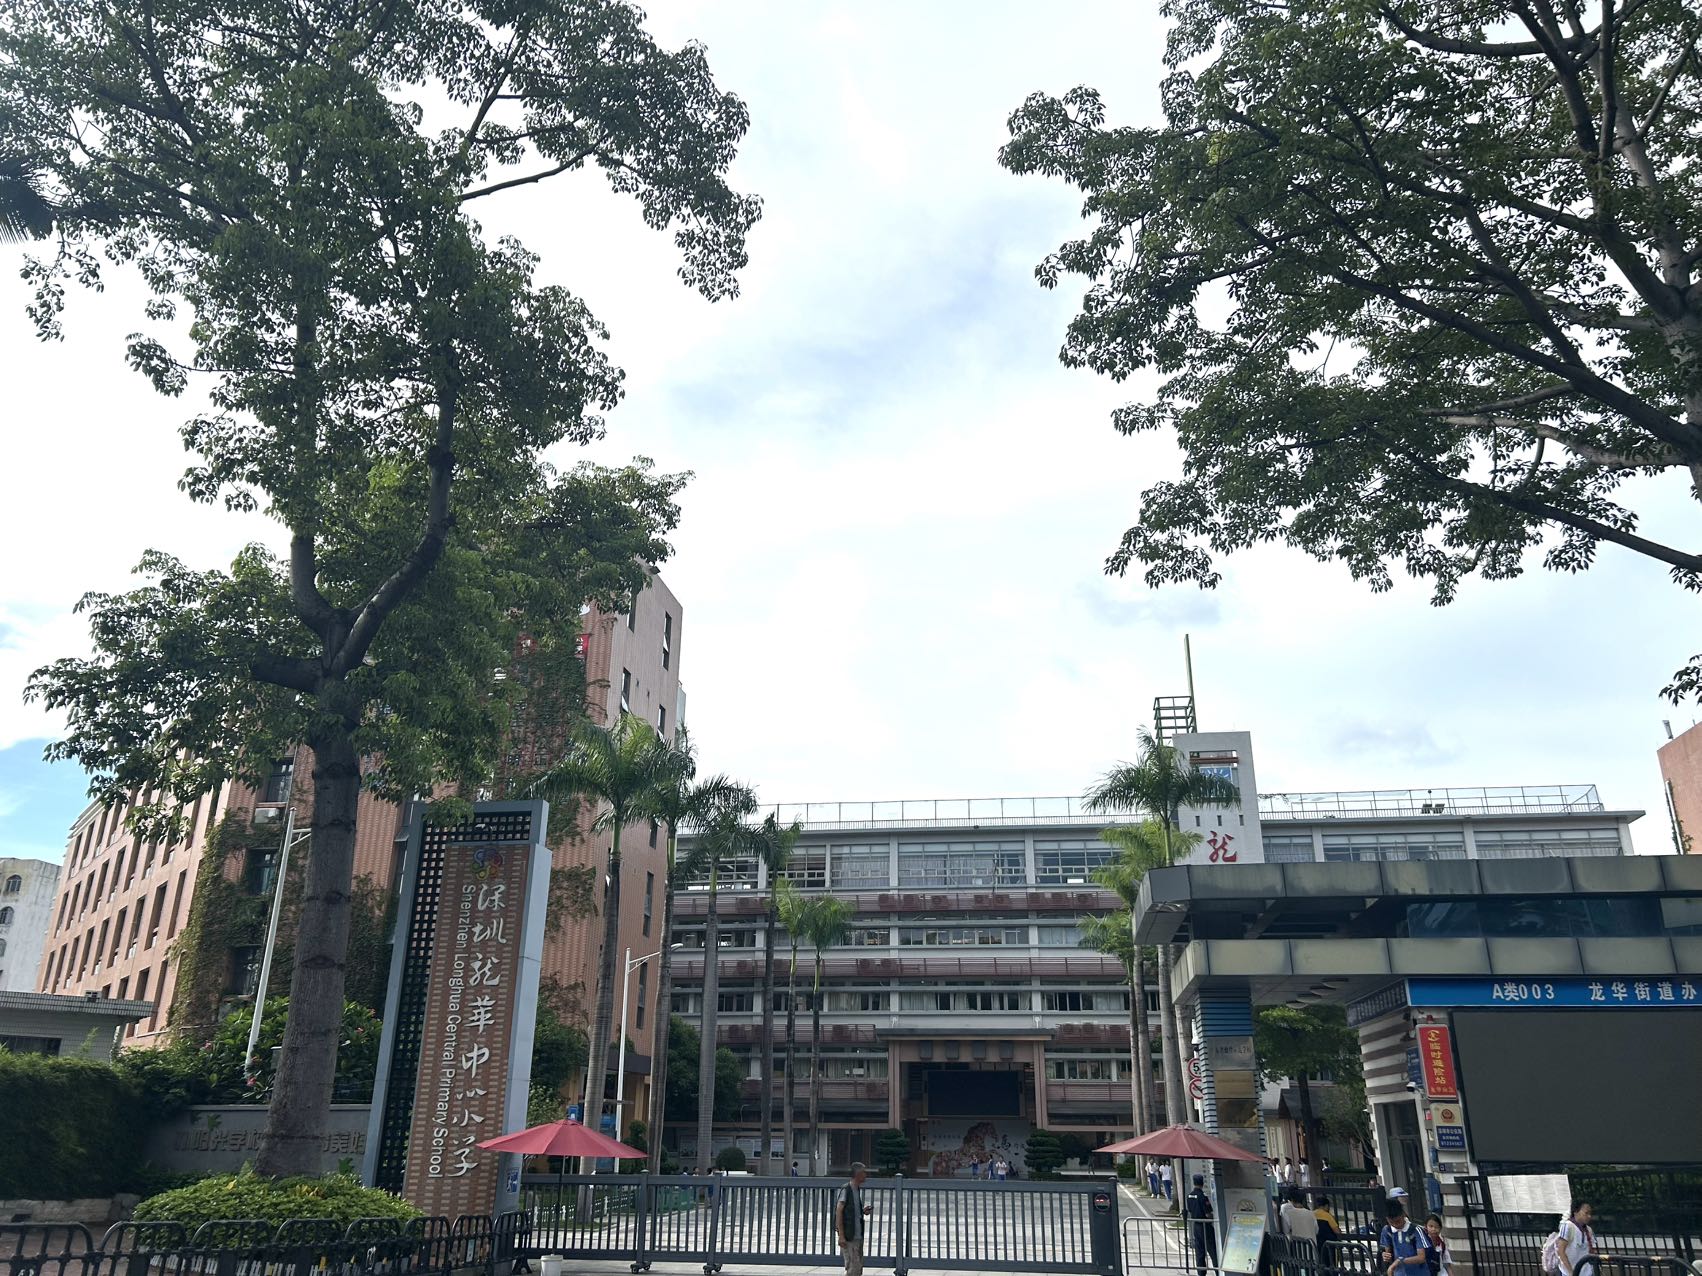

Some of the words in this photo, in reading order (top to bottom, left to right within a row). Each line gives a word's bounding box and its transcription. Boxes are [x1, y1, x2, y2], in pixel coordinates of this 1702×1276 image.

[456, 884, 476, 948] Shenzhen
[448, 953, 469, 1010] Longhua
[1492, 982, 1555, 1000] A类003
[1588, 981, 1697, 1001] 龙华街道办
[442, 1015, 462, 1065] Central
[432, 1067, 456, 1125] Primary
[428, 1127, 449, 1178] School
